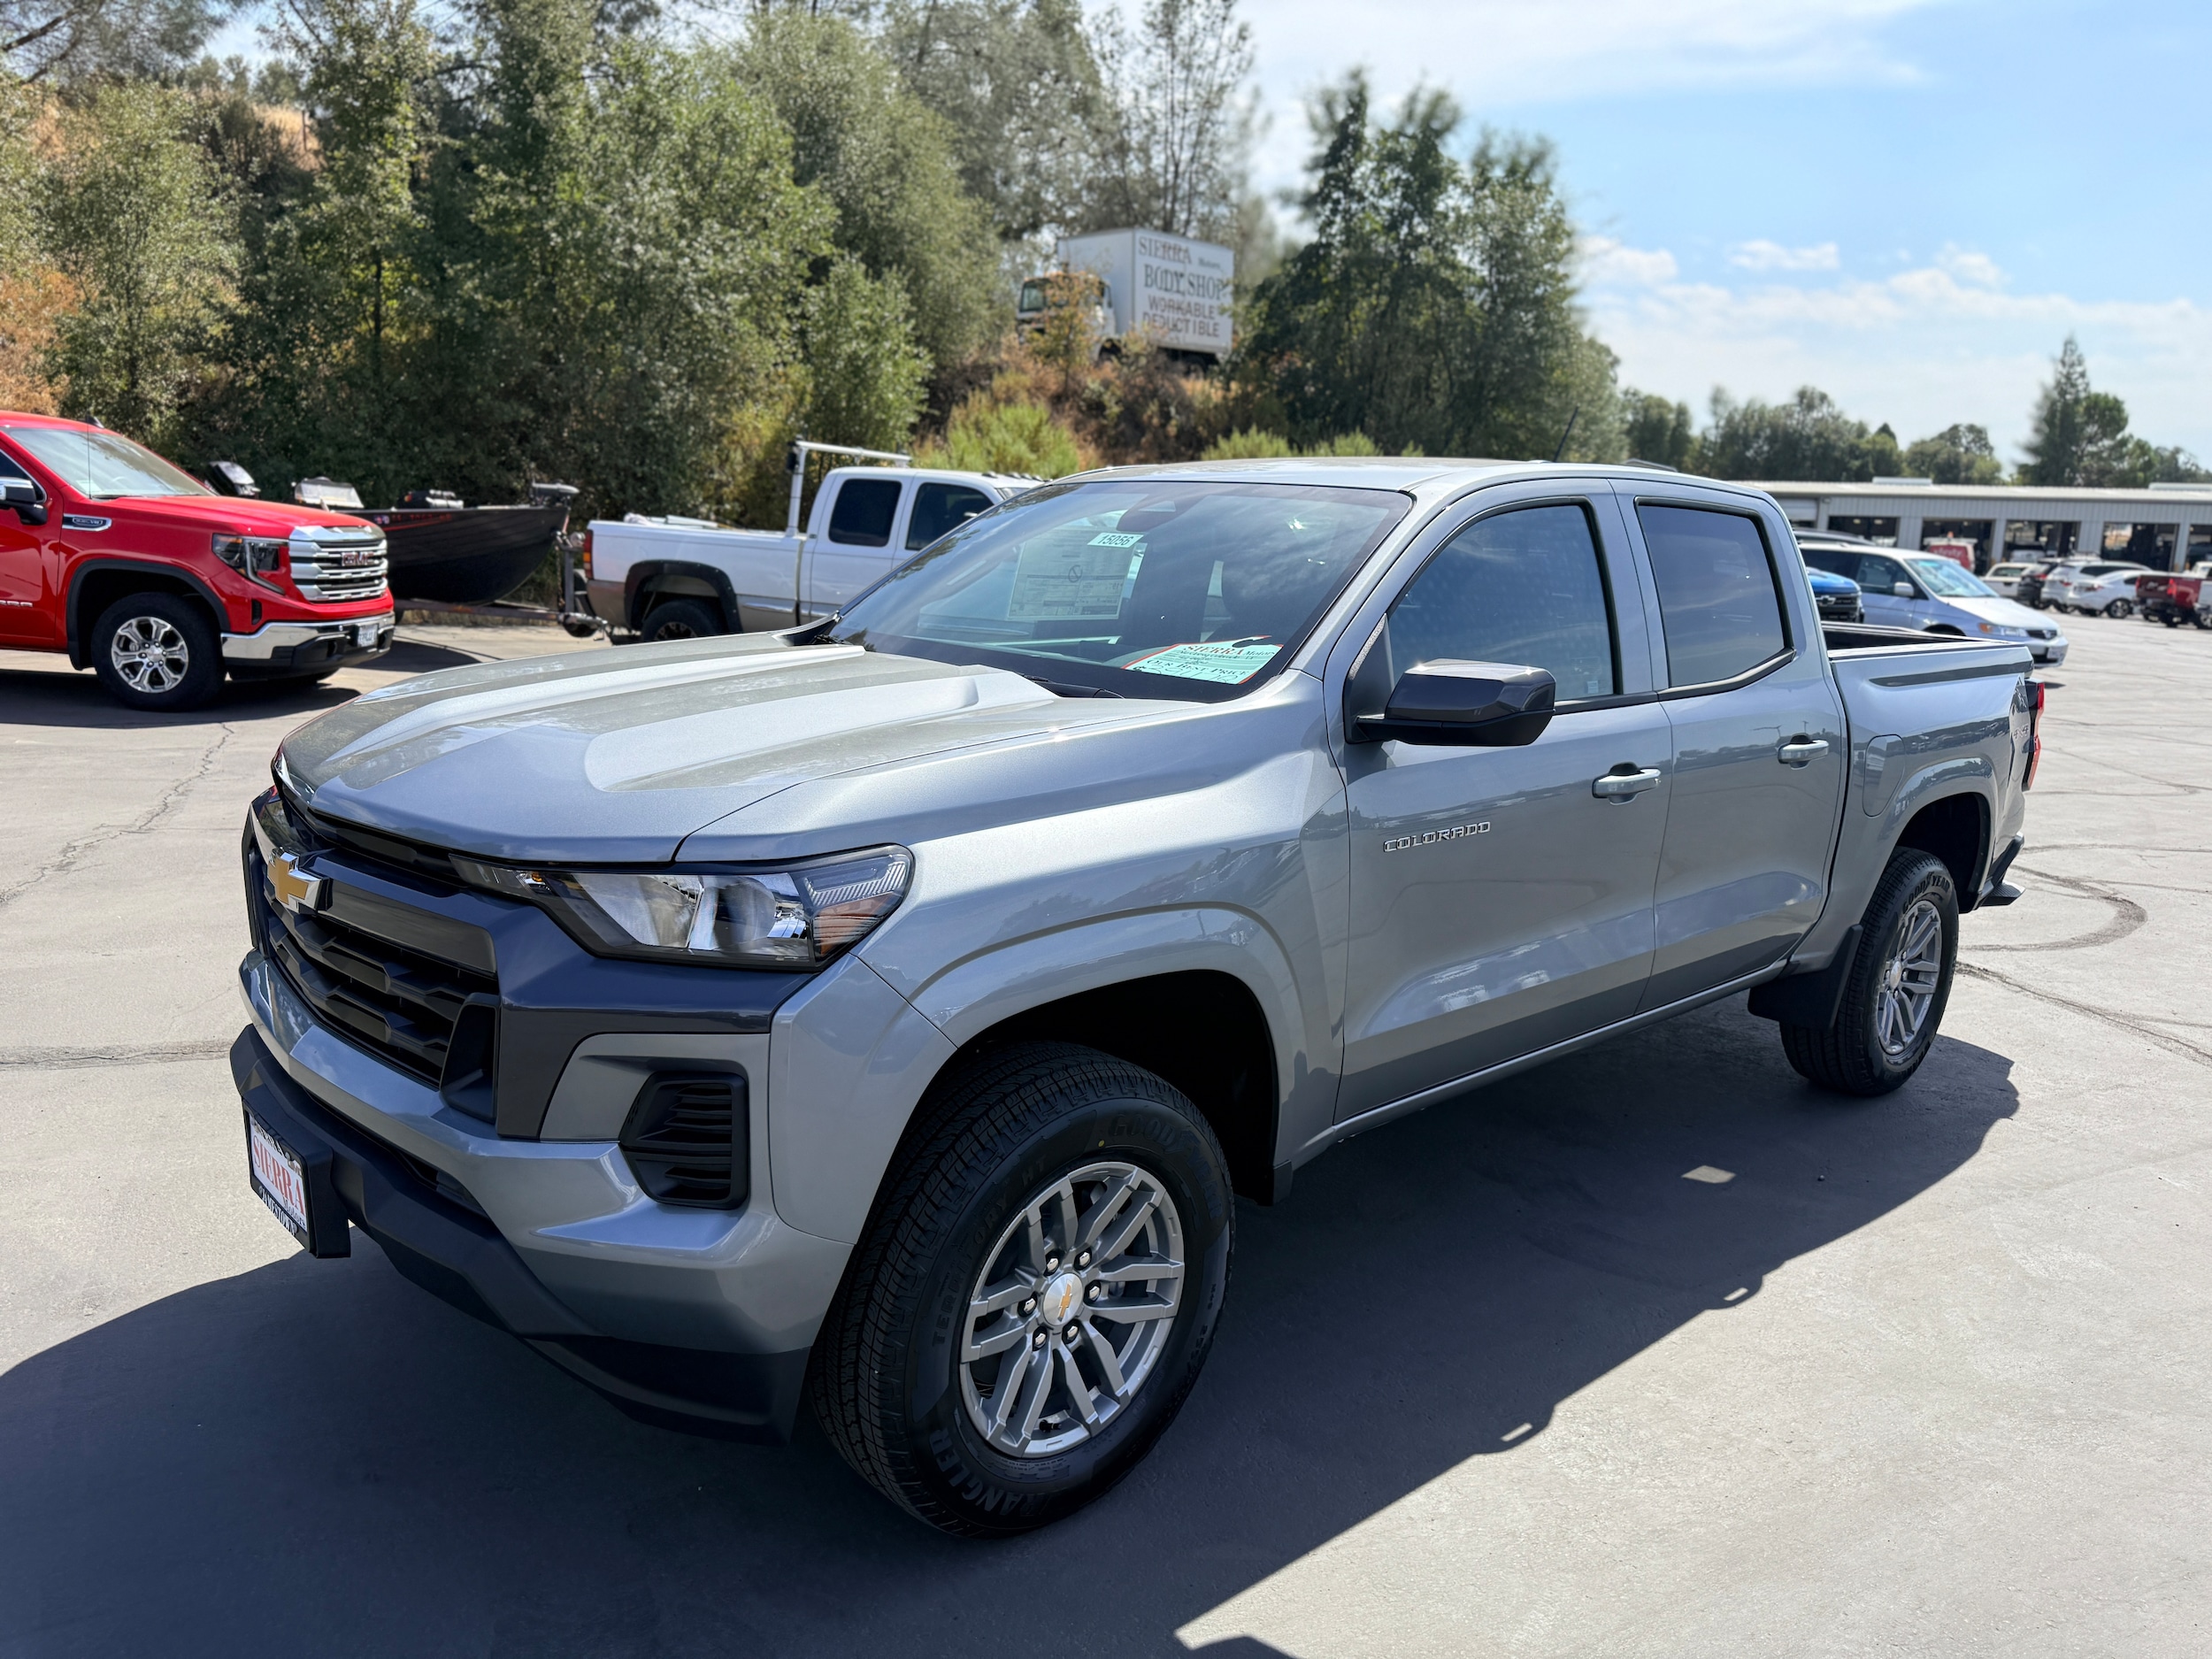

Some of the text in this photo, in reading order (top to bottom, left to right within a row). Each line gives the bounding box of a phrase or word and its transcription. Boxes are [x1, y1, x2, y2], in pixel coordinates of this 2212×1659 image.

[1139, 236, 1192, 265] SIERRA
[1144, 264, 1225, 300] BODY SHOP
[1148, 296, 1216, 320] WORKABLE
[1098, 534, 1133, 546] 15056
[342, 551, 375, 566] GMC
[1184, 645, 1245, 656] SIERRA
[1384, 821, 1491, 852] COLORADO
[253, 1135, 305, 1216] SIERRA
